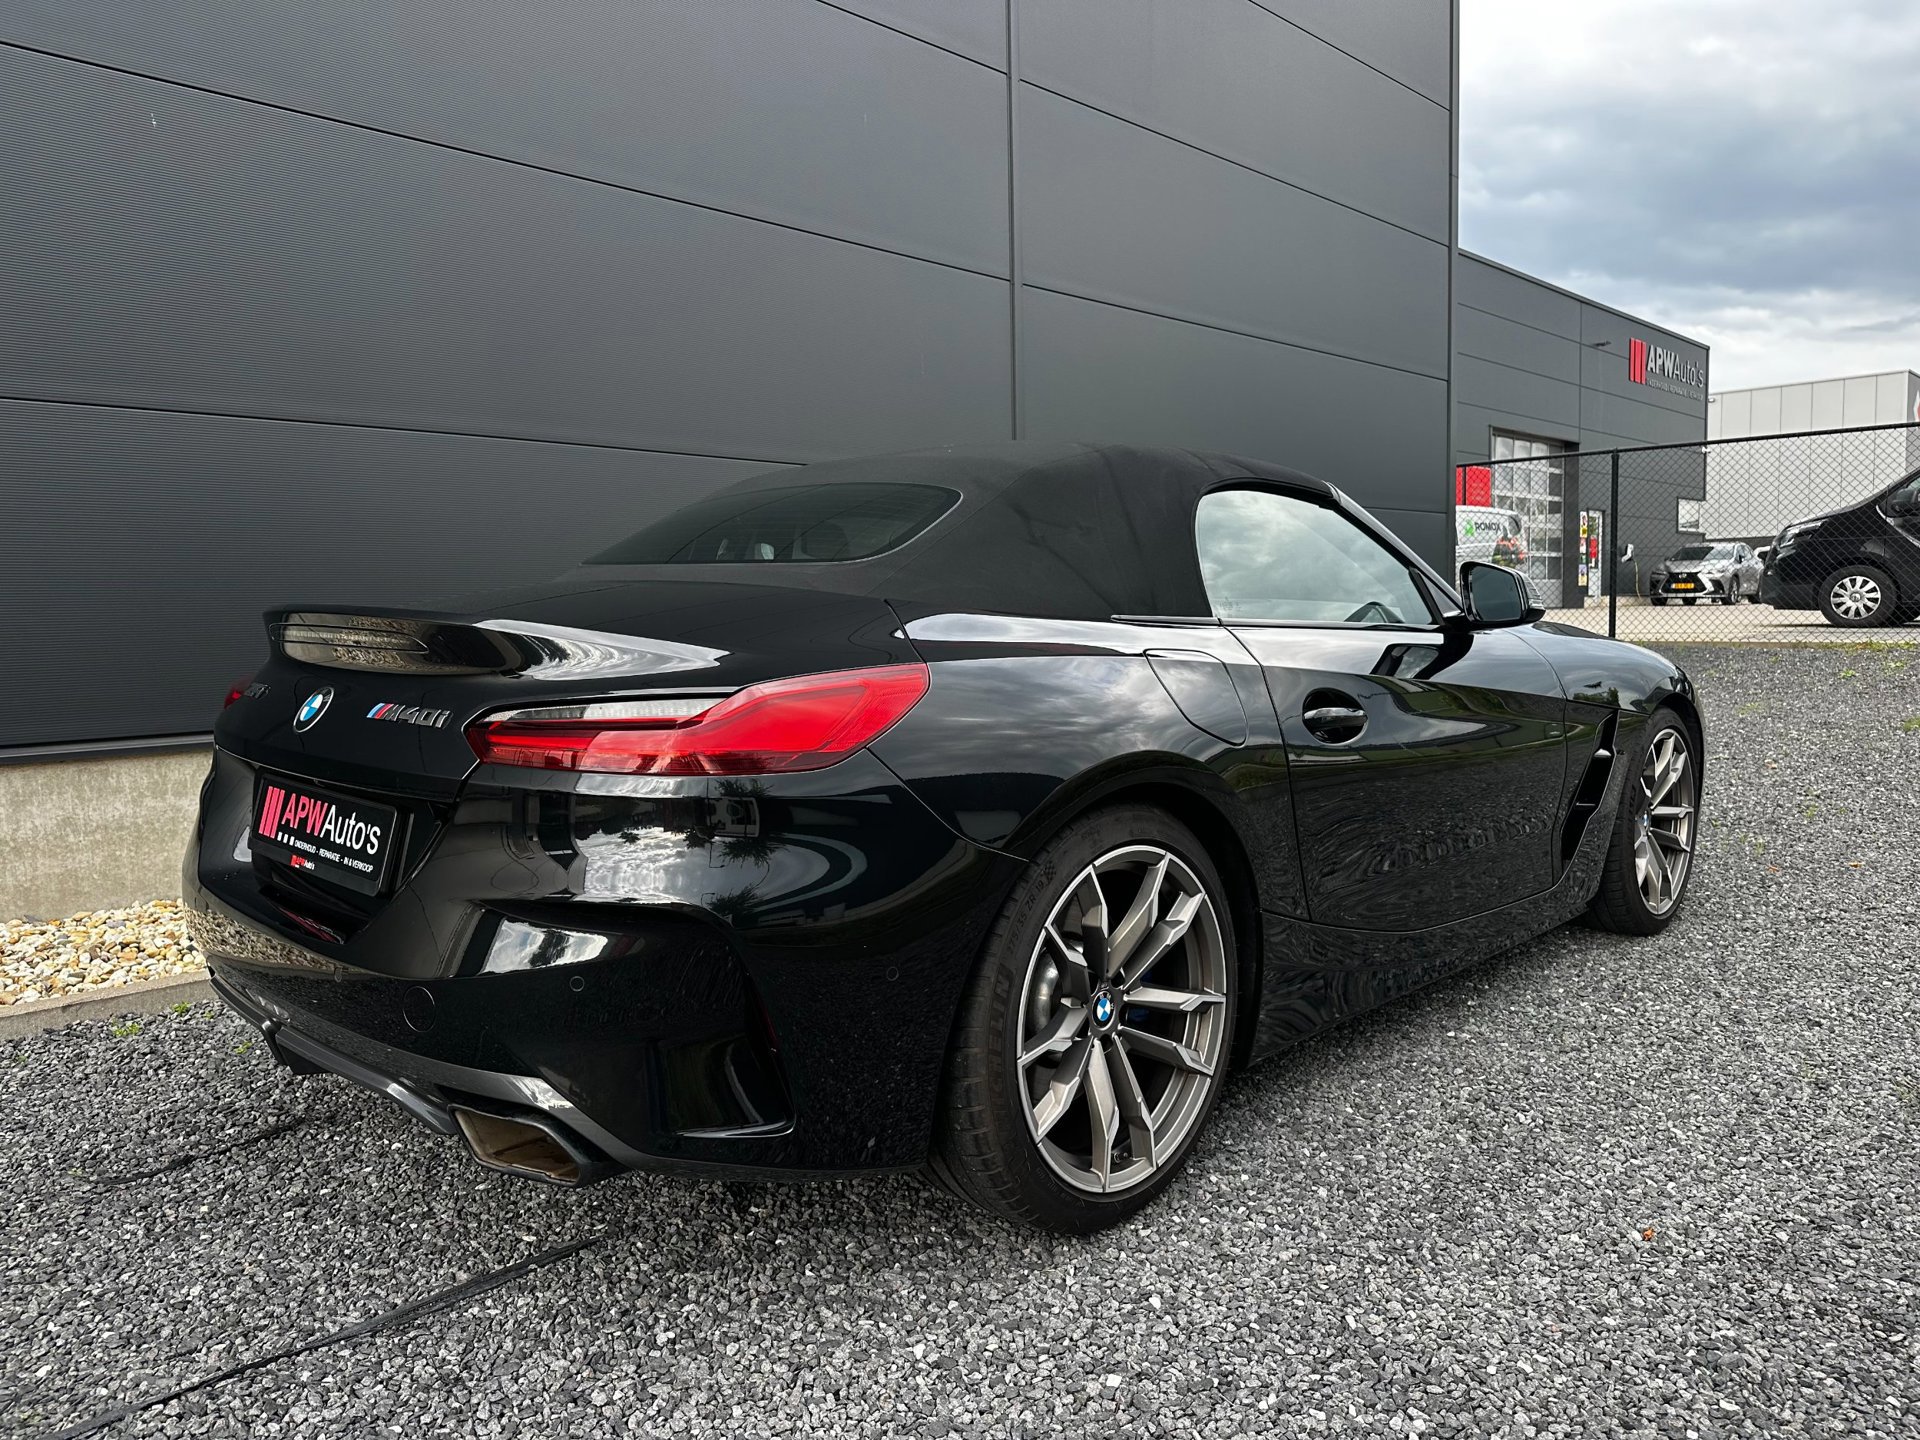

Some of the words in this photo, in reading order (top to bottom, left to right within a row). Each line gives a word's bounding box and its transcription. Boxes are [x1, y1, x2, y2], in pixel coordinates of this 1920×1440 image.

[1647, 344, 1704, 388] APWAuto's
[379, 703, 452, 728] M40i
[281, 793, 381, 855] APWAuto's
